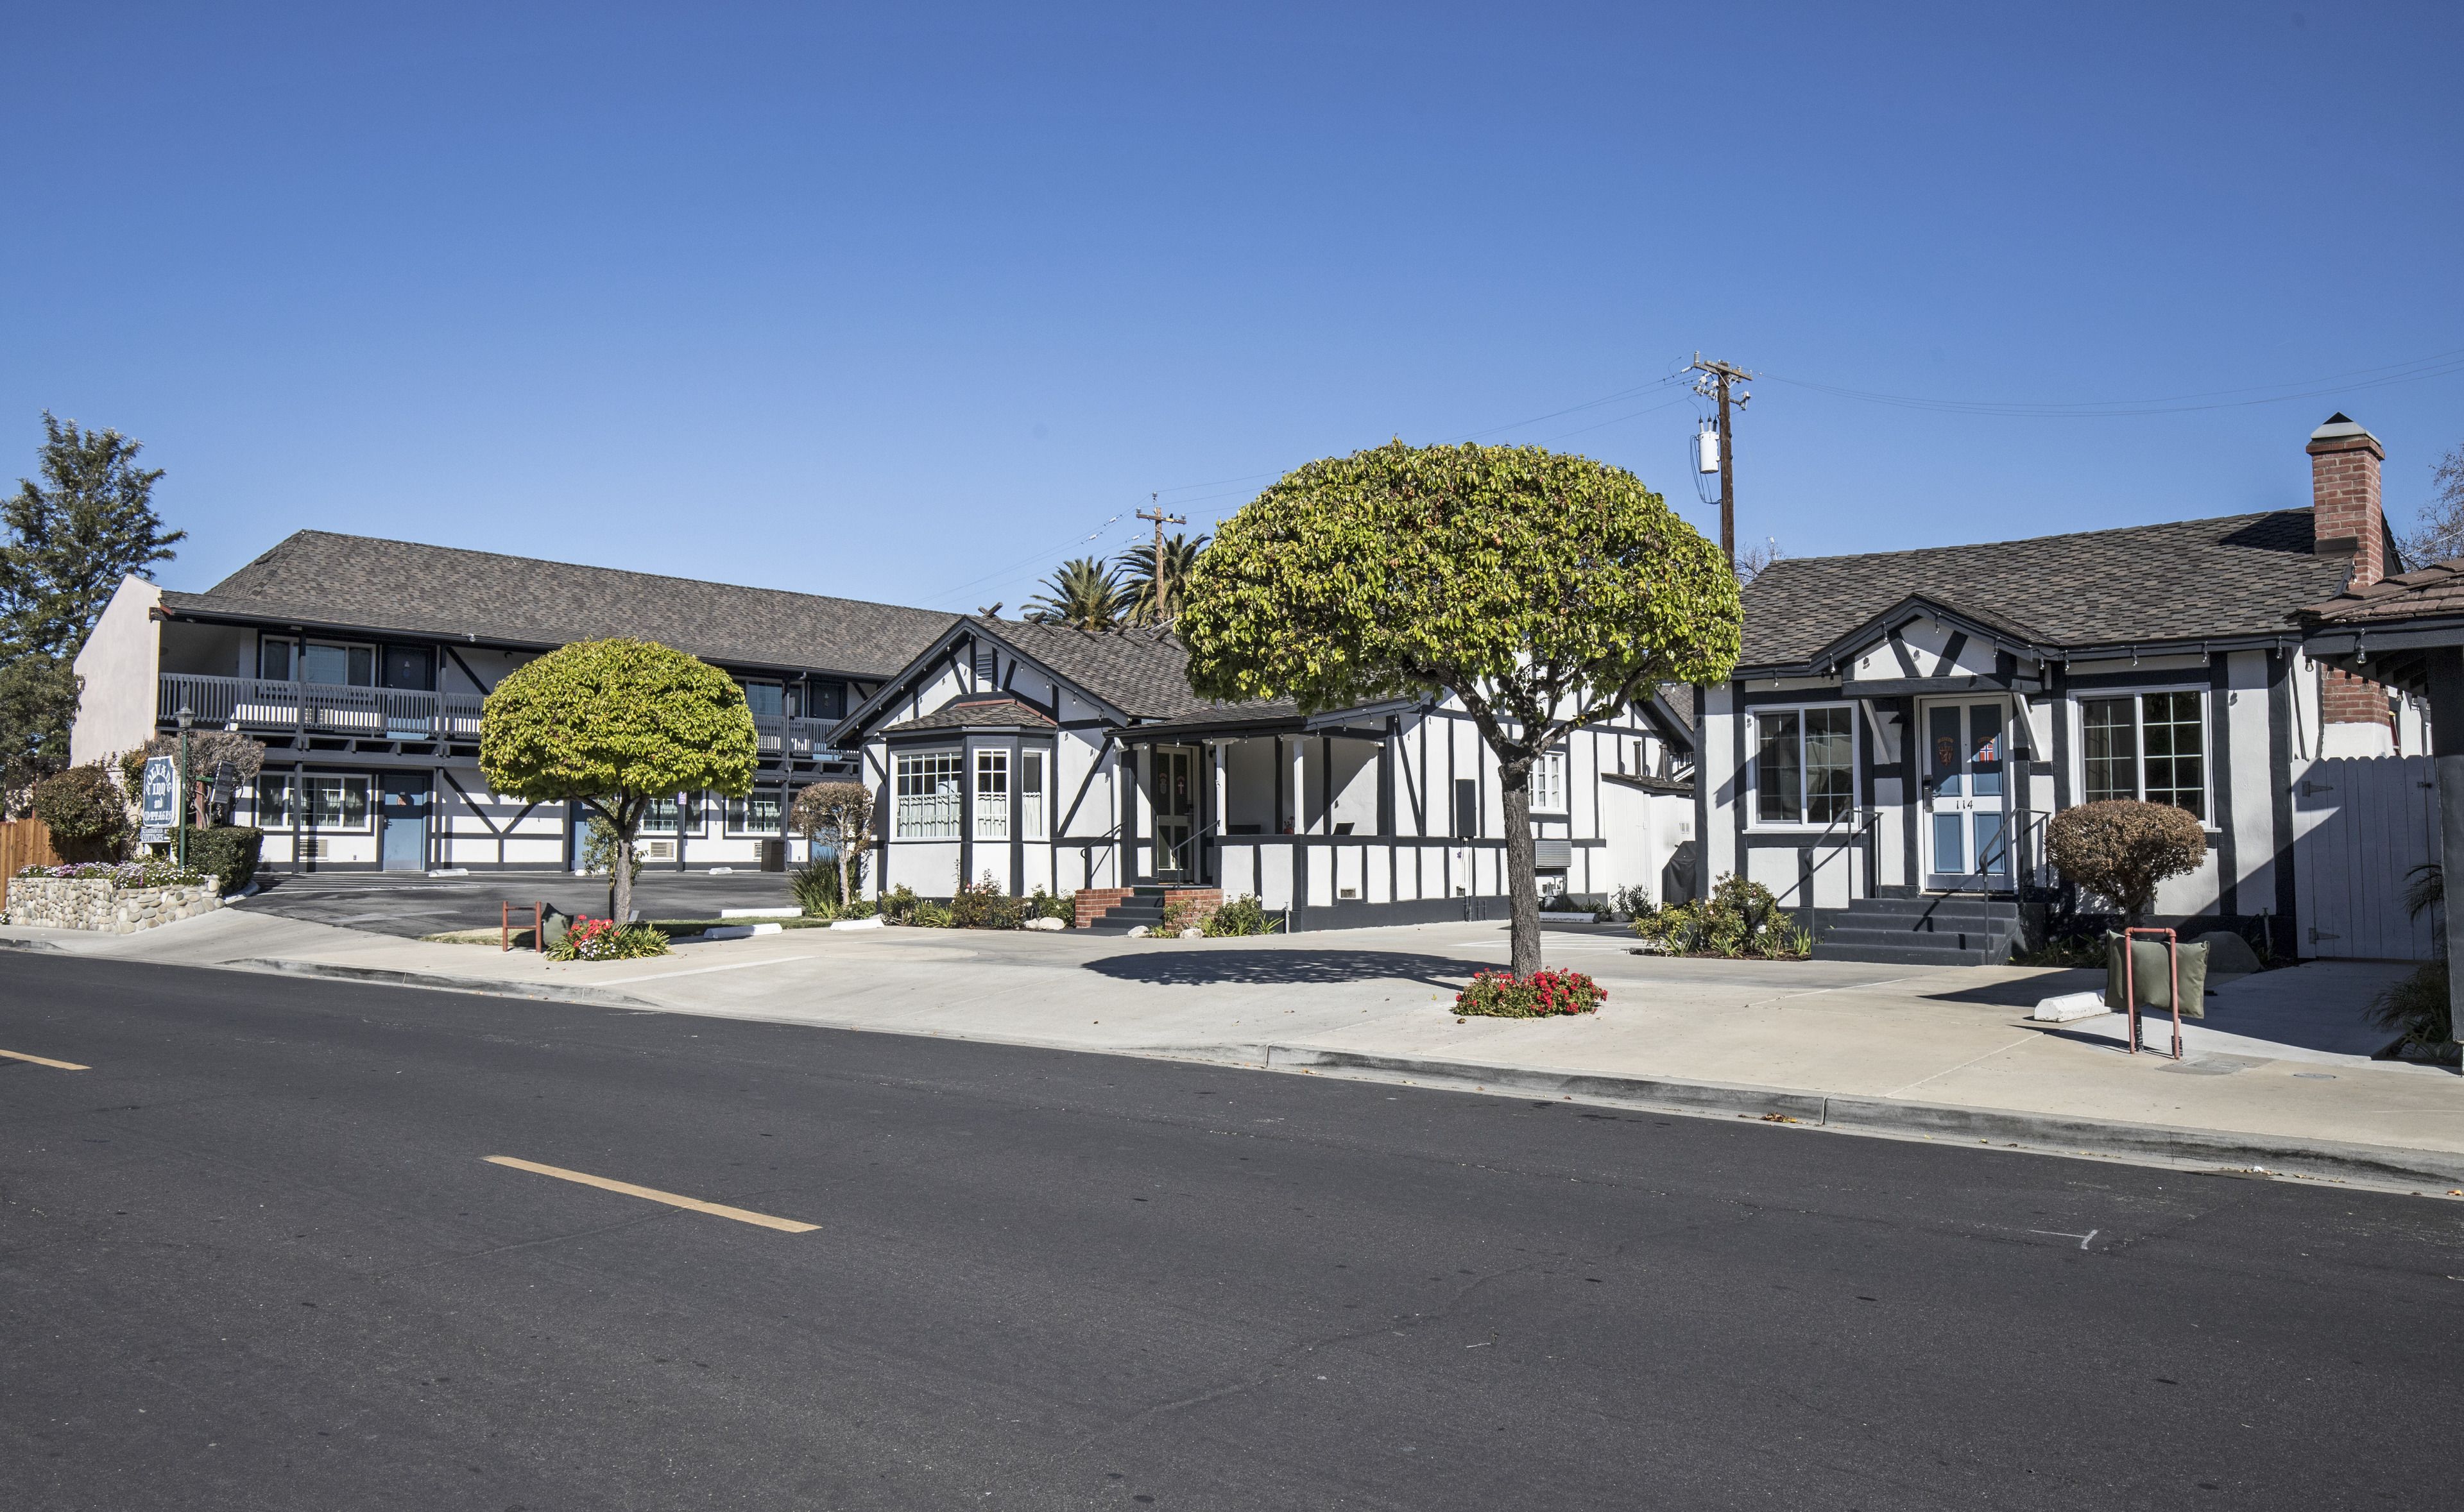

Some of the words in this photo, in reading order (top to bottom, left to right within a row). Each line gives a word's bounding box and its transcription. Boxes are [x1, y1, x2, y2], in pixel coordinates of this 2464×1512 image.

[146, 764, 172, 795] SOLVANG
[154, 797, 163, 809] and
[1956, 800, 1973, 810] 114
[144, 811, 171, 822] COTTAGES
[142, 833, 164, 842] COTTAGES
